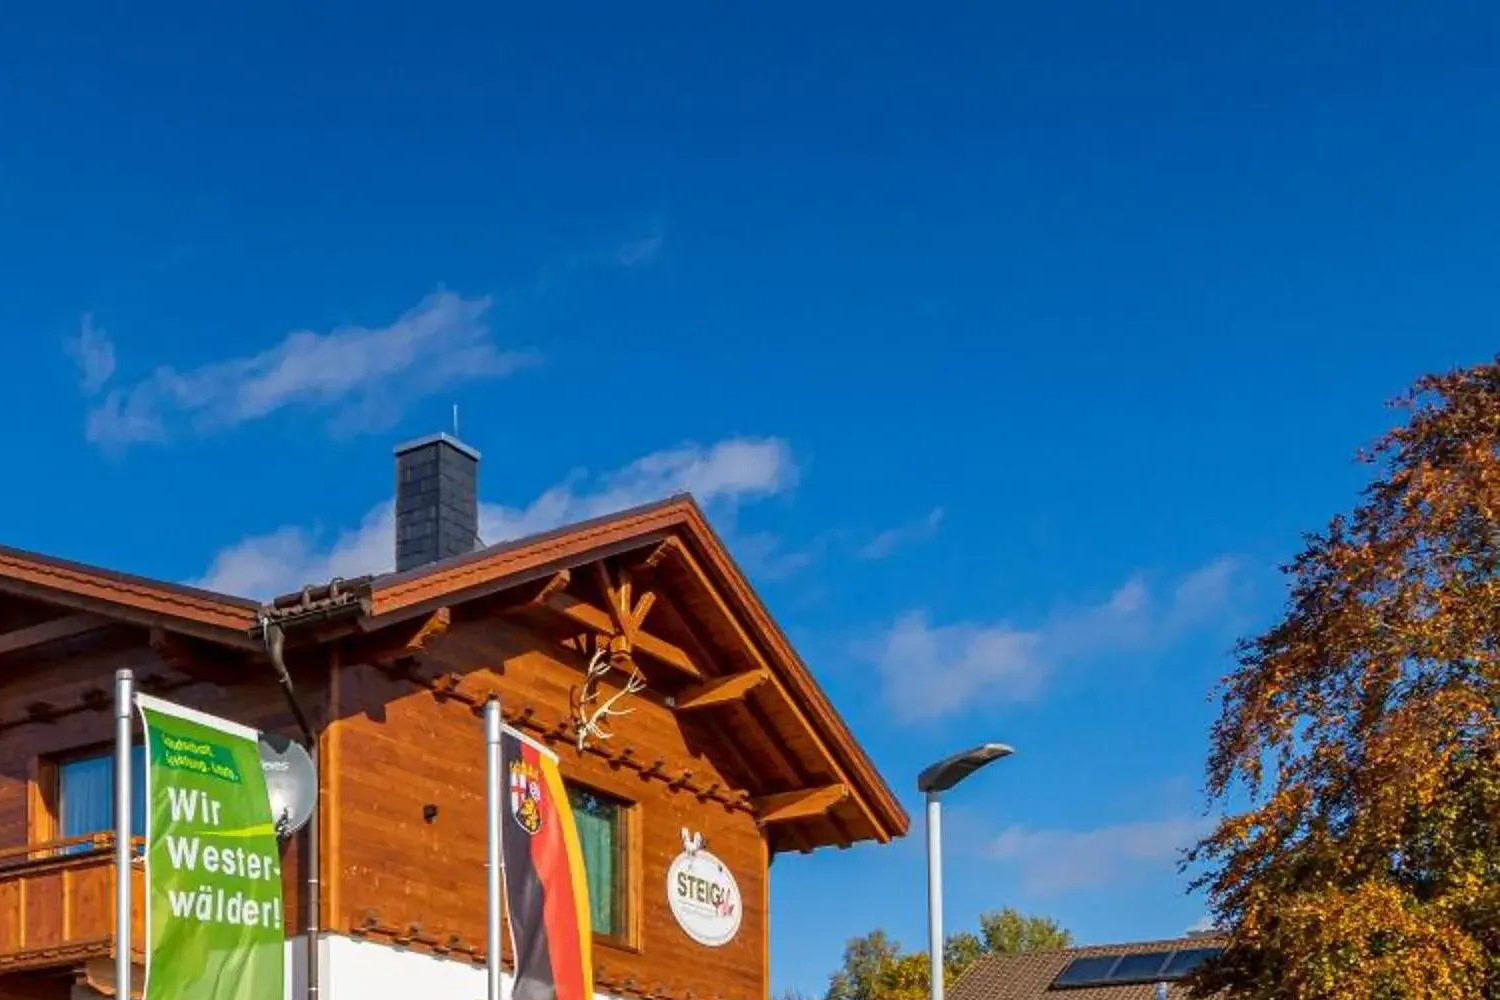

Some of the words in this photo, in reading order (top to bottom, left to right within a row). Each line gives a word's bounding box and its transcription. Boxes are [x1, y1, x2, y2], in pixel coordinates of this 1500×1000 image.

[167, 786, 221, 826] Wir
[165, 835, 281, 881] Wester-
[168, 884, 281, 929] wälder!
[677, 871, 721, 906] STEIG
